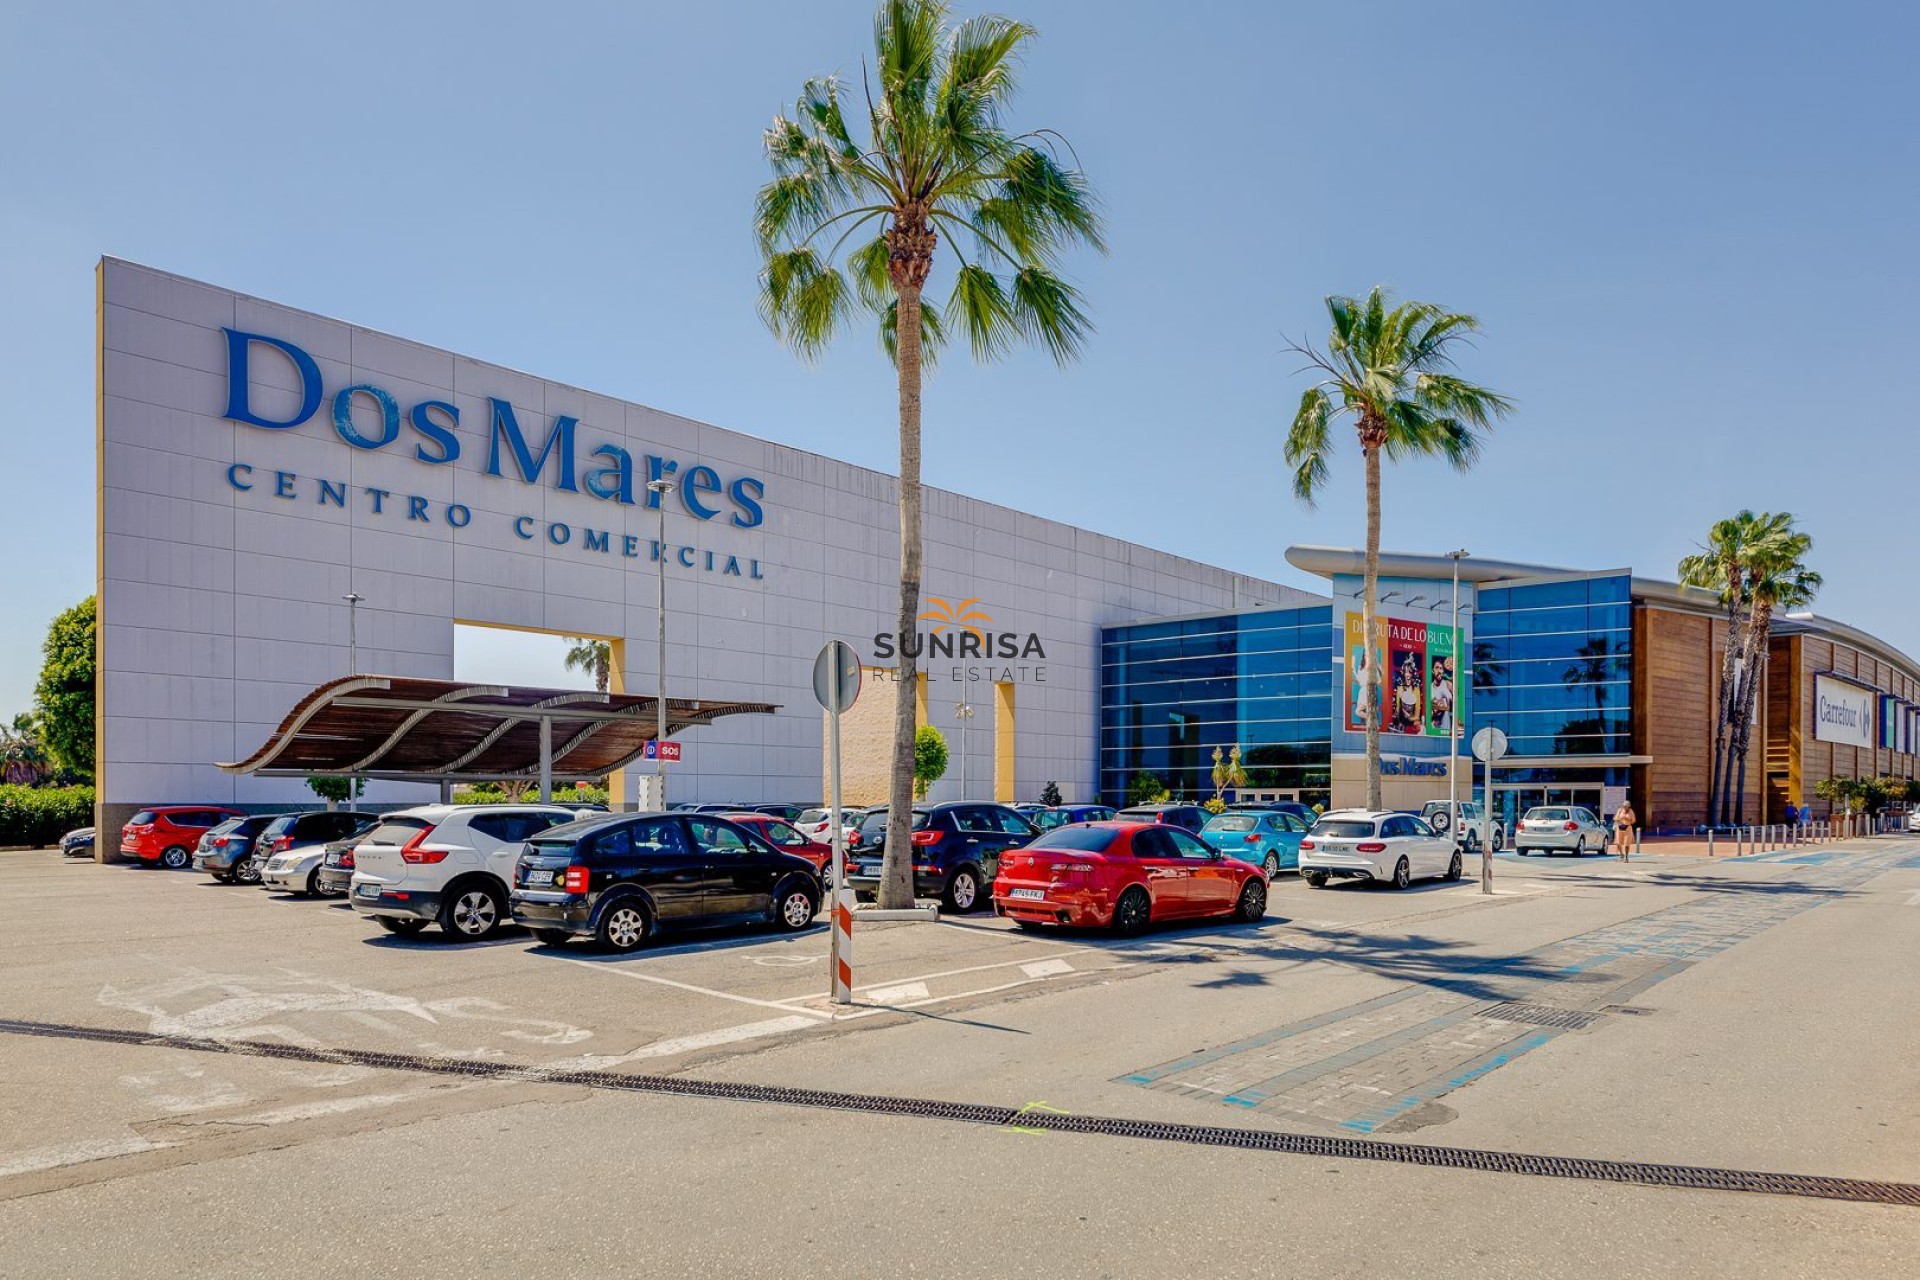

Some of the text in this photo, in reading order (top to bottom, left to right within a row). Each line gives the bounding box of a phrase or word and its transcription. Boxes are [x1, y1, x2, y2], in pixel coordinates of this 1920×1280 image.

[221, 326, 765, 529] Dos Mares
[228, 463, 764, 580] CENTRO COMERCIAL
[1353, 619, 1399, 639] DIRUTA
[1400, 626, 1414, 641] DE
[1415, 629, 1426, 642] LO
[1819, 695, 1857, 727] Carrefour
[662, 746, 679, 755] SOS
